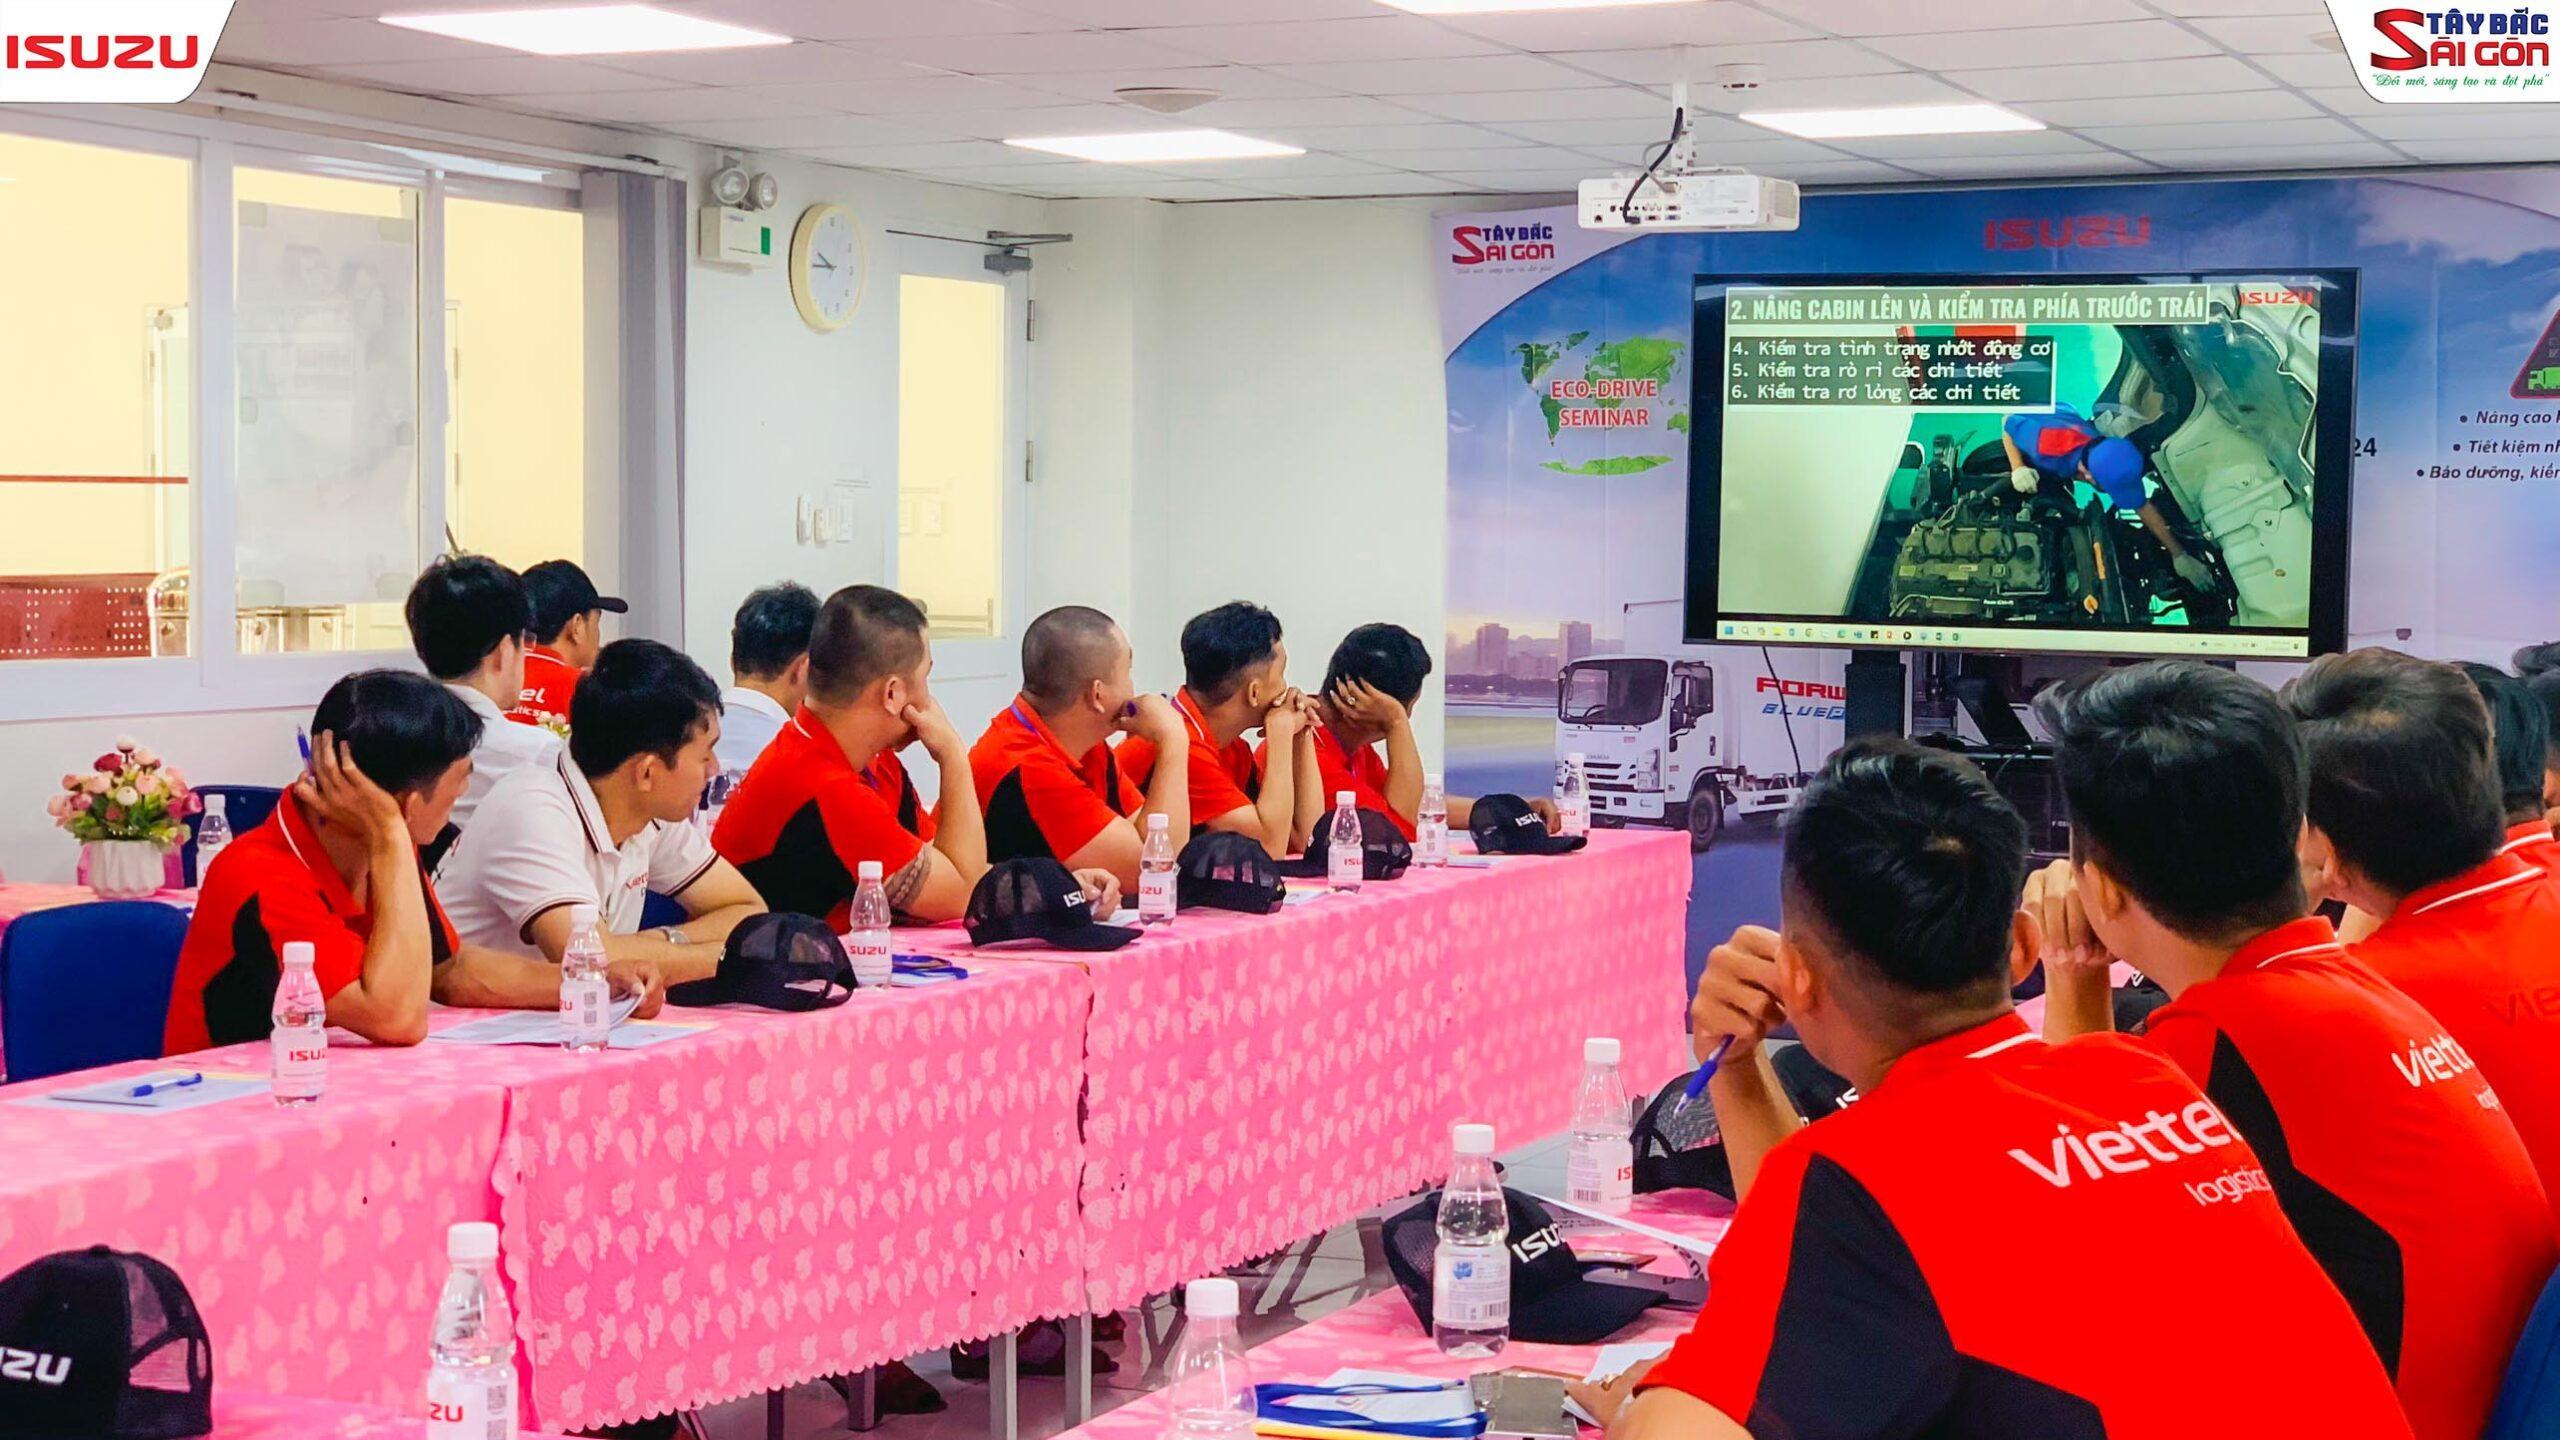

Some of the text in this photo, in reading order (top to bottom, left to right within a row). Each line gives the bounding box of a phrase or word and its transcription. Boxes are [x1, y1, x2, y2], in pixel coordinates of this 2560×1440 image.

[1482, 225, 1516, 242] TÂY
[1985, 215, 2149, 250] ISUZU
[1731, 290, 2204, 320] 2. NÂNG CABIN LÊN VÀ KIỂM TRA PHÍA TRƯỚC TRÁI
[2241, 291, 2313, 305] ISUZU
[1732, 343, 1749, 356] 4.
[1803, 342, 1831, 356] tra
[1840, 340, 1876, 356] tình
[1883, 341, 1931, 360] trạng
[1937, 340, 1976, 356] nhớt
[1982, 340, 2023, 360] động
[2029, 341, 2051, 356] cơ
[1732, 364, 1749, 378] 5.
[1803, 364, 1831, 378] tra
[1838, 361, 1857, 378] rò
[1891, 361, 1920, 378] các
[1928, 362, 1955, 378] chi
[1966, 361, 2003, 378] tiết
[1551, 379, 1658, 399] ECO-DRIVE
[1731, 385, 1749, 399] 6.
[1802, 385, 1830, 400] tra
[1909, 383, 1938, 400] các
[1945, 385, 1973, 400] chi
[1982, 382, 2021, 400] tiết
[1559, 408, 1649, 427] SEMINAR
[2523, 413, 2551, 424] cao
[2469, 439, 2498, 454] Tiết
[2502, 440, 2540, 457] kiệm
[1511, 1222, 1566, 1264] ISU
[0, 1346, 72, 1385] ZU
